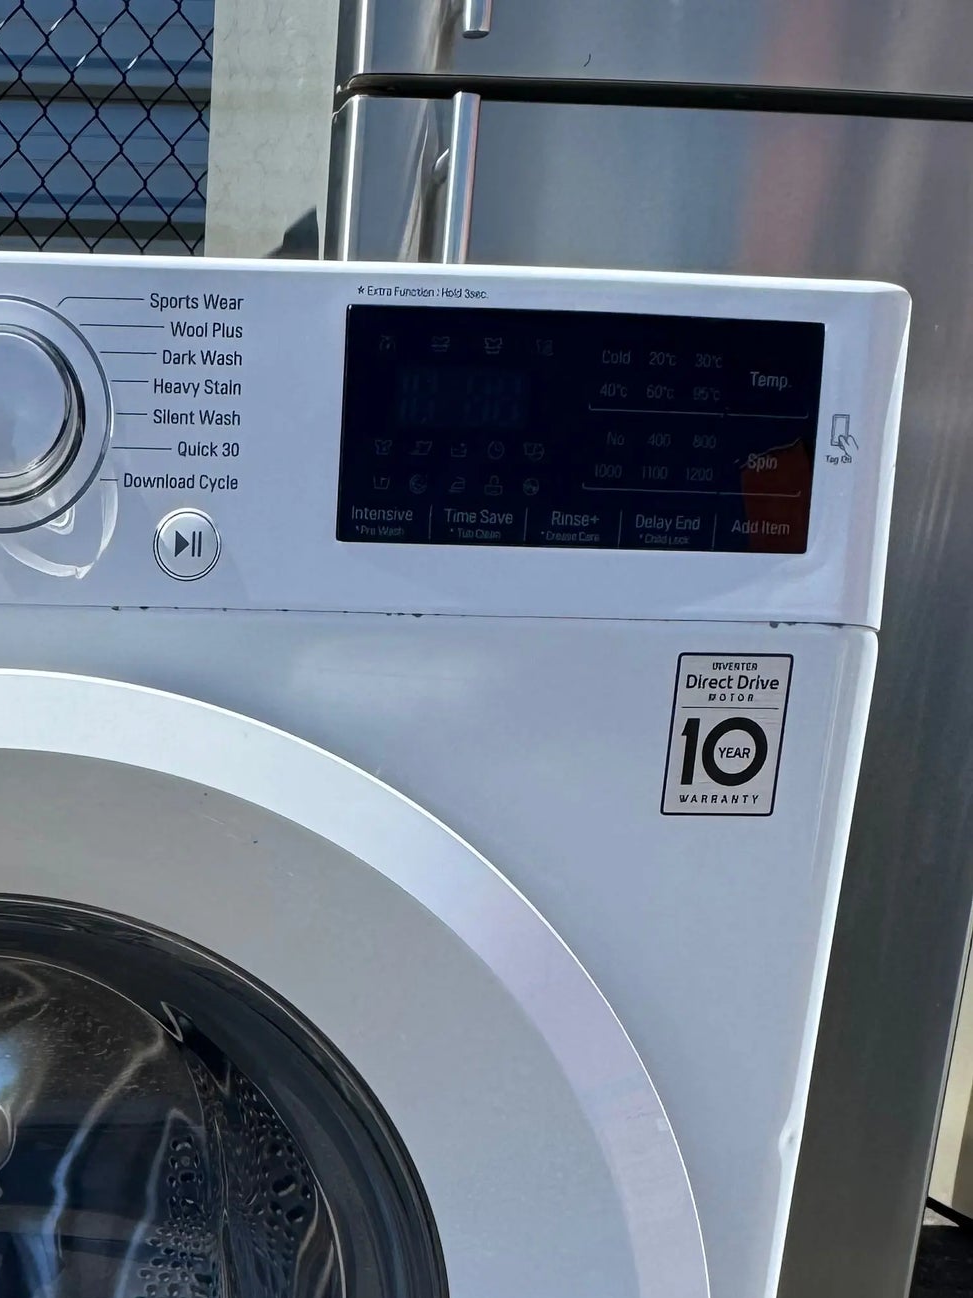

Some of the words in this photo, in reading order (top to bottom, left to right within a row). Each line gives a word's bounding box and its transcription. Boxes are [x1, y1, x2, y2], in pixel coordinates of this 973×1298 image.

[367, 286, 392, 297] Extra
[394, 286, 435, 298] Function
[442, 288, 462, 299] Hold
[149, 293, 199, 313] Sports
[203, 294, 244, 311] Wear
[170, 322, 207, 338] Wool
[212, 323, 243, 339] Plus
[162, 349, 195, 366] Dark
[200, 349, 242, 367] Wash
[602, 350, 631, 364] Cold
[153, 379, 200, 398] Heavy
[204, 379, 242, 396] Stain
[749, 371, 792, 390] Temp.
[153, 408, 194, 426] Silent
[198, 409, 241, 426] Wash
[177, 440, 218, 458] Quick
[222, 441, 240, 457] 30
[647, 433, 671, 447] 400
[692, 435, 716, 449] 800
[748, 453, 778, 472] Spin
[825, 455, 839, 465] Tag
[594, 463, 622, 478] 1000
[642, 465, 667, 480] 1100
[685, 467, 713, 482] 1200
[123, 472, 195, 490] Download
[198, 473, 239, 492] Cycle
[351, 505, 413, 521] Intensive
[444, 508, 476, 524] Time
[480, 509, 513, 525] Save
[551, 510, 600, 527] Rinse+
[636, 514, 673, 533] Delay
[676, 515, 700, 531] End
[732, 519, 758, 534] Add
[762, 520, 790, 536] Item
[686, 674, 734, 689] Direct
[737, 675, 779, 690] Drive
[708, 693, 754, 702] MOTOR
[680, 717, 768, 786] 10
[718, 747, 751, 759] YEAR
[679, 794, 759, 804] WARRANTY
